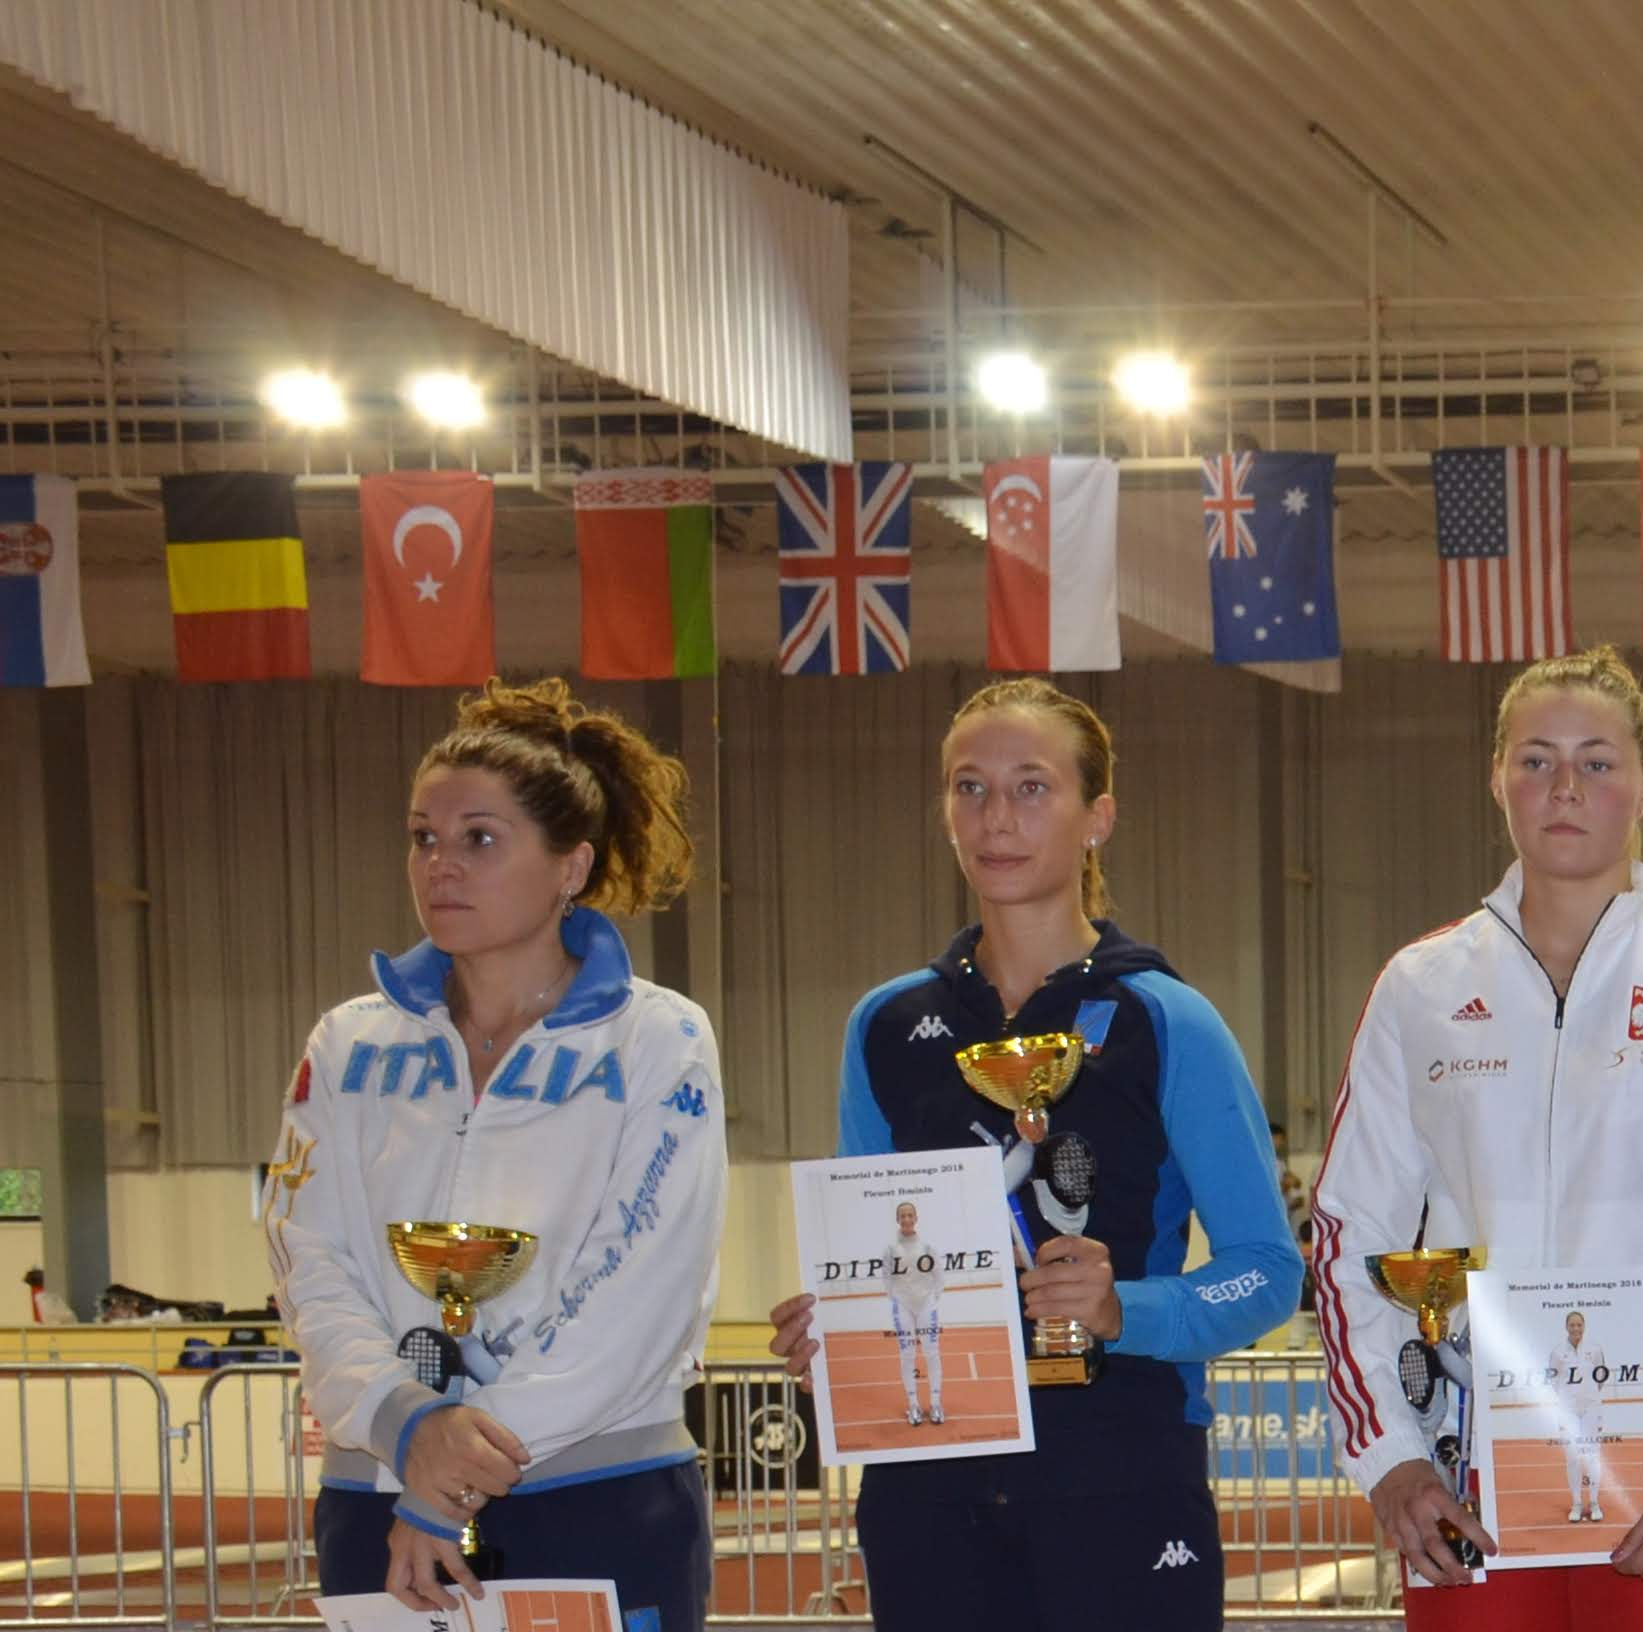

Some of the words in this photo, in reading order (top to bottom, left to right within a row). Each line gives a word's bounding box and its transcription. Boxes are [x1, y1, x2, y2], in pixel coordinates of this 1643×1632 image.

[1452, 1011, 1492, 1021] adidas
[342, 1035, 626, 1105] ITALIA
[1451, 1059, 1508, 1073] KGHM
[823, 1250, 994, 1281] DIPLOME
